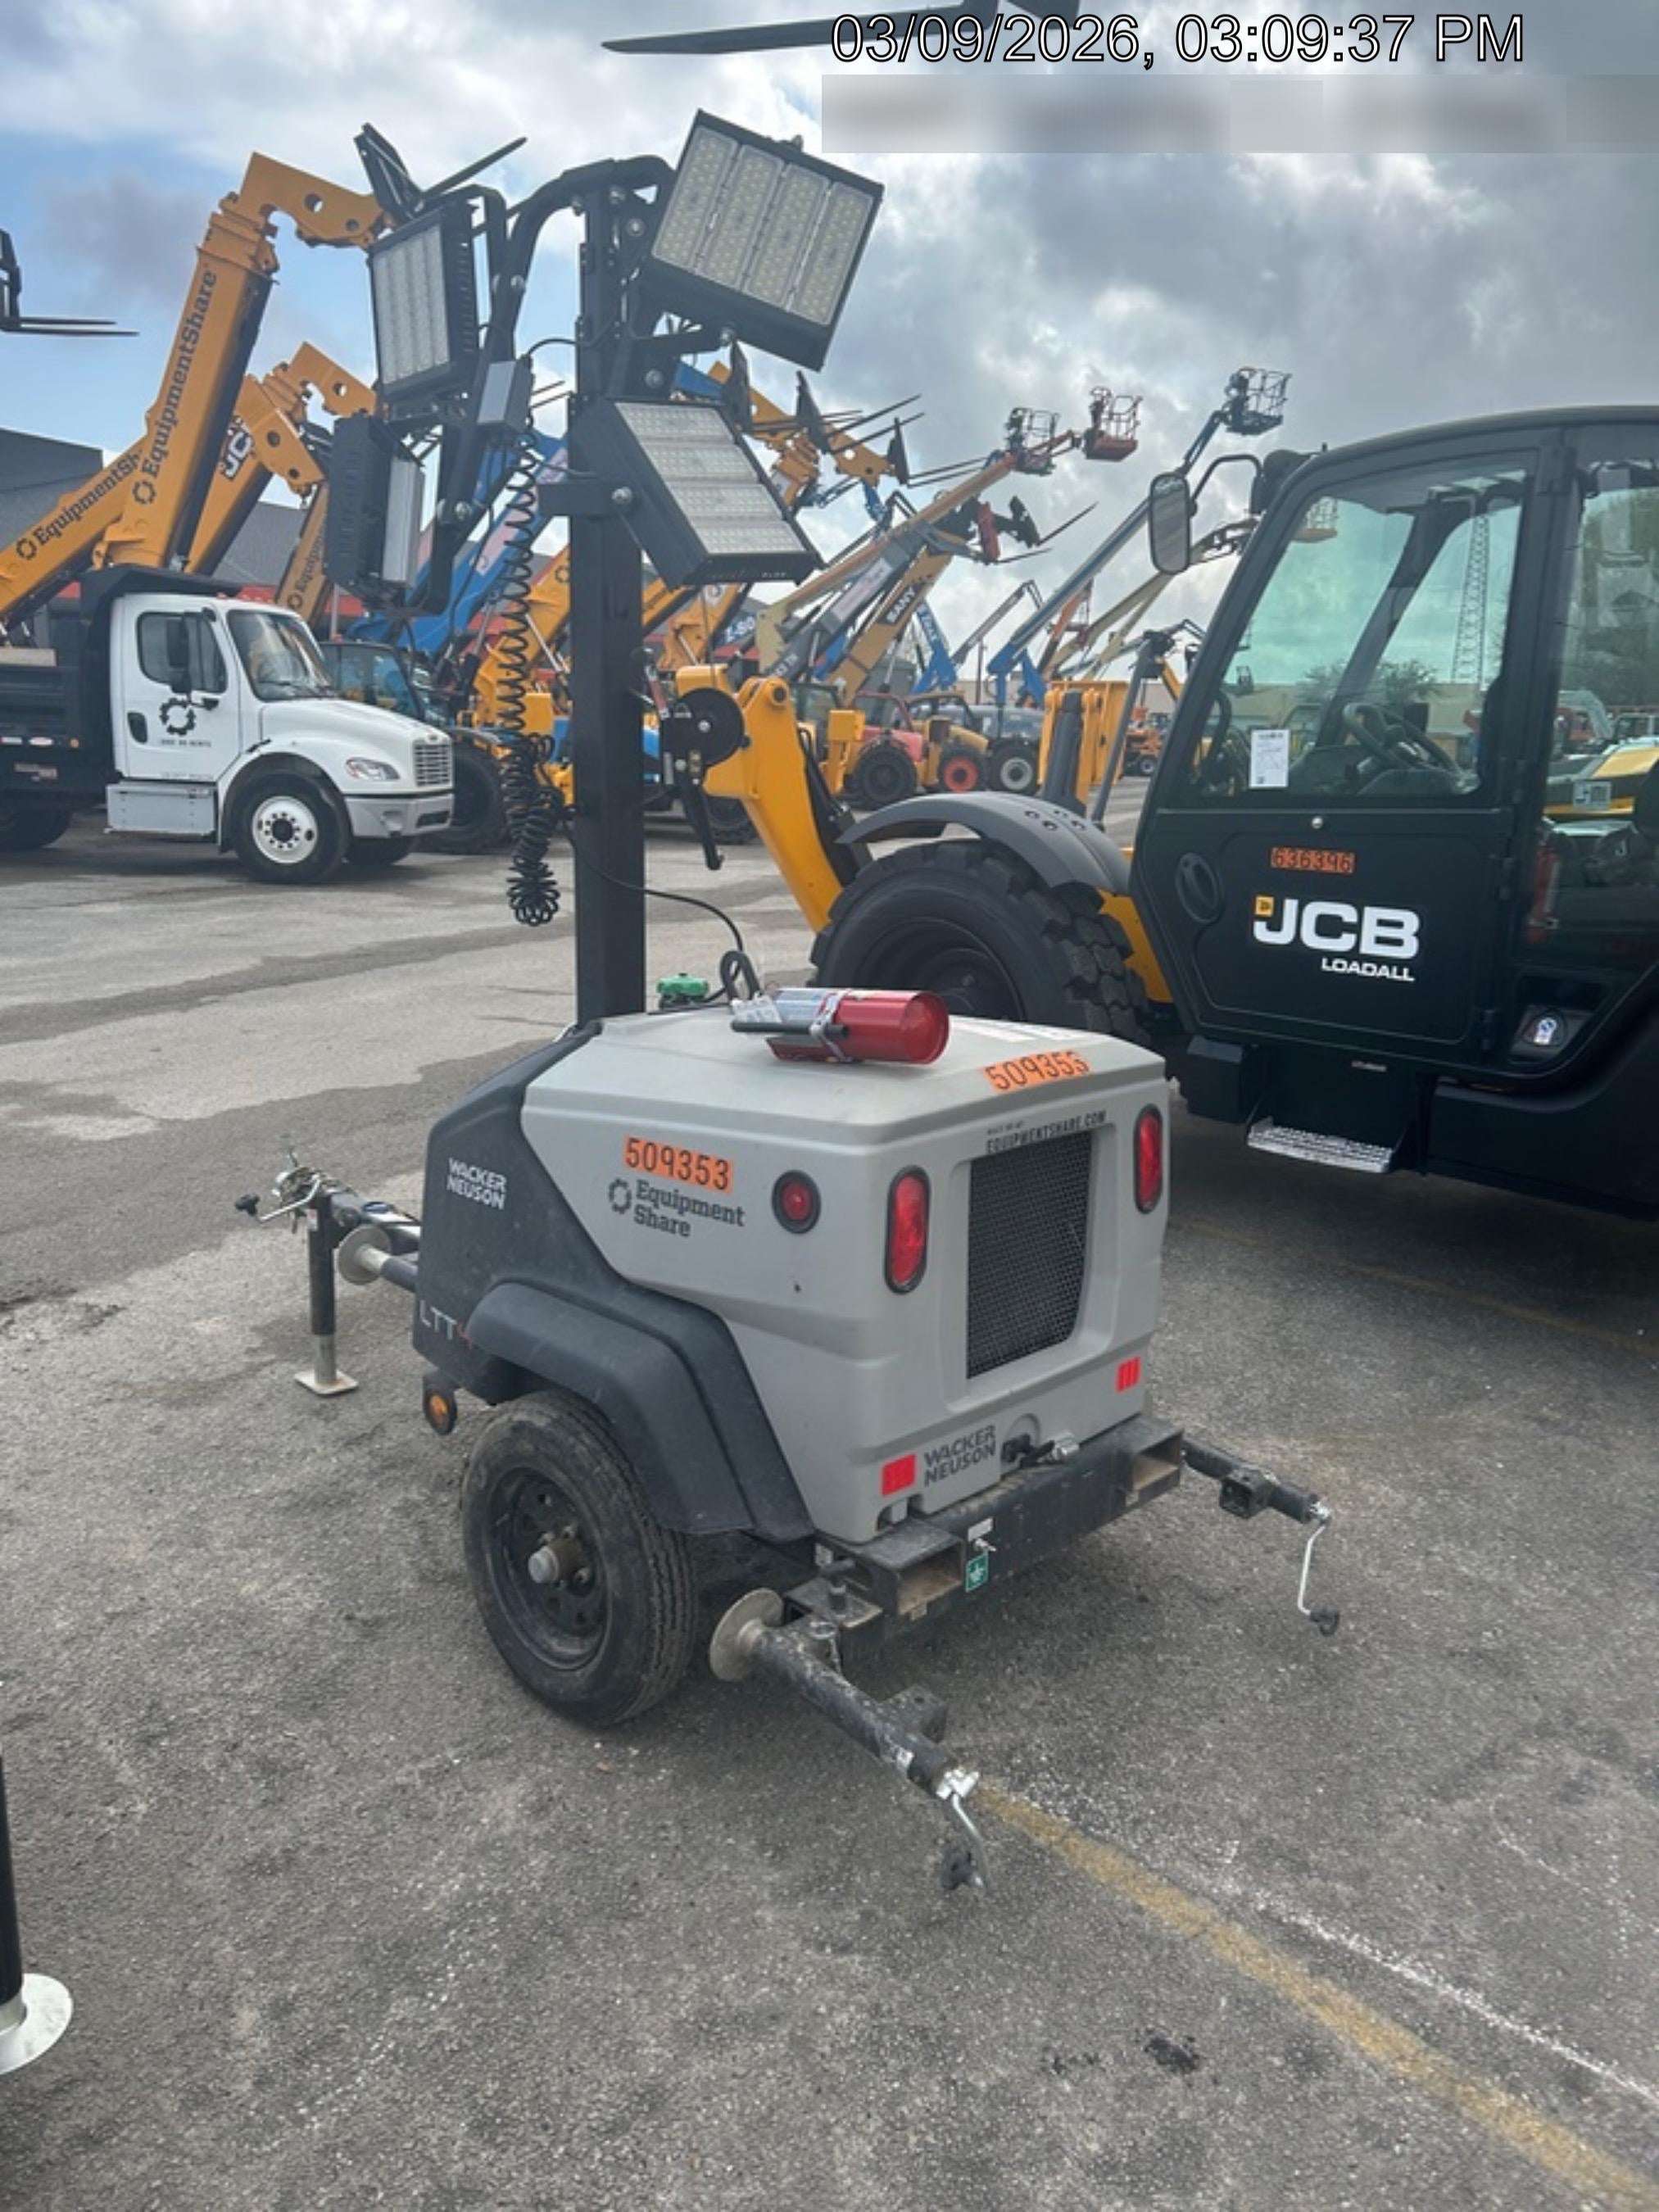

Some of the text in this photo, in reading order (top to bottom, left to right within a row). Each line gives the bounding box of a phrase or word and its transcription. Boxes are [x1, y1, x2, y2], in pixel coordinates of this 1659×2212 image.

[143, 270, 216, 478] EquipmentShare
[886, 586, 916, 623] SANY
[1273, 848, 1352, 872] 636396
[1253, 896, 1420, 959] JCB
[1321, 957, 1416, 981] LOADALL
[986, 1109, 1107, 1154] EQUIPMENTSHARE.COM
[448, 1157, 507, 1193] WACKER
[625, 1136, 729, 1190] 509353
[446, 1174, 505, 1210] NEUSON
[636, 1179, 745, 1227] Equipment
[633, 1204, 691, 1237] Share
[923, 1425, 996, 1468] WACKER
[923, 1444, 996, 1488] NEUSON
